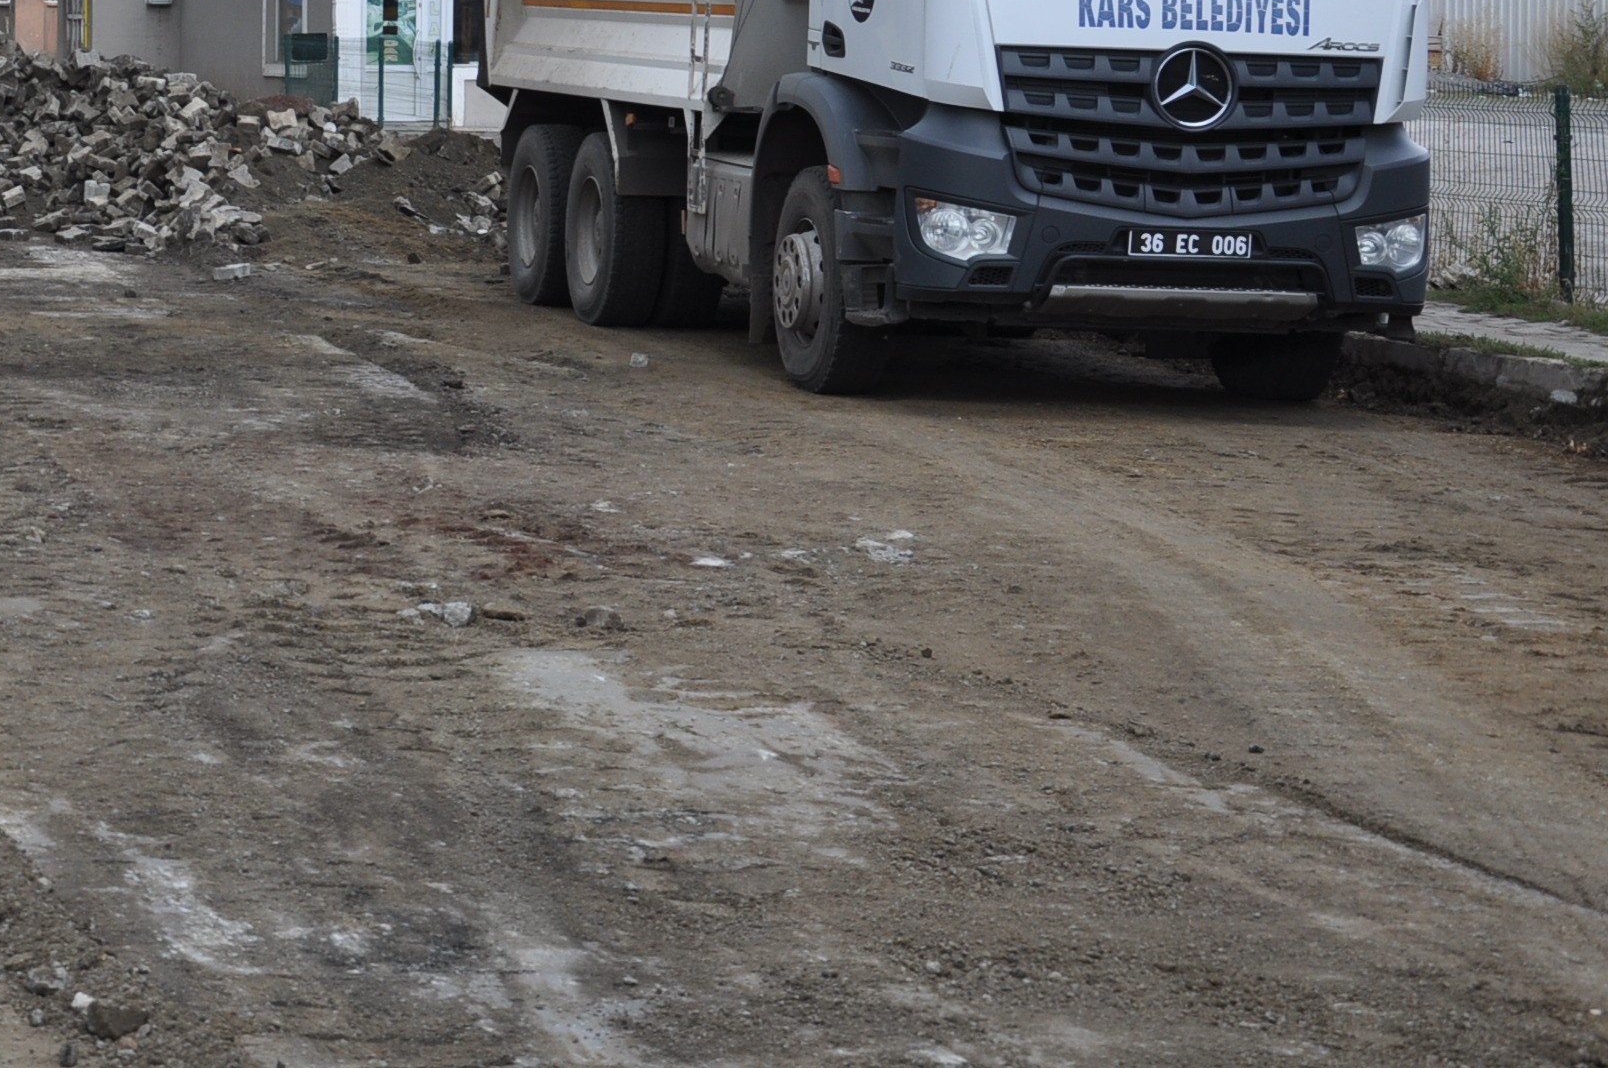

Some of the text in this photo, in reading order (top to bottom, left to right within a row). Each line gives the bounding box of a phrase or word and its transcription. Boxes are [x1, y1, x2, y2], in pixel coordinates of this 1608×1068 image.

[1140, 232, 1247, 255] 36 EC 006
